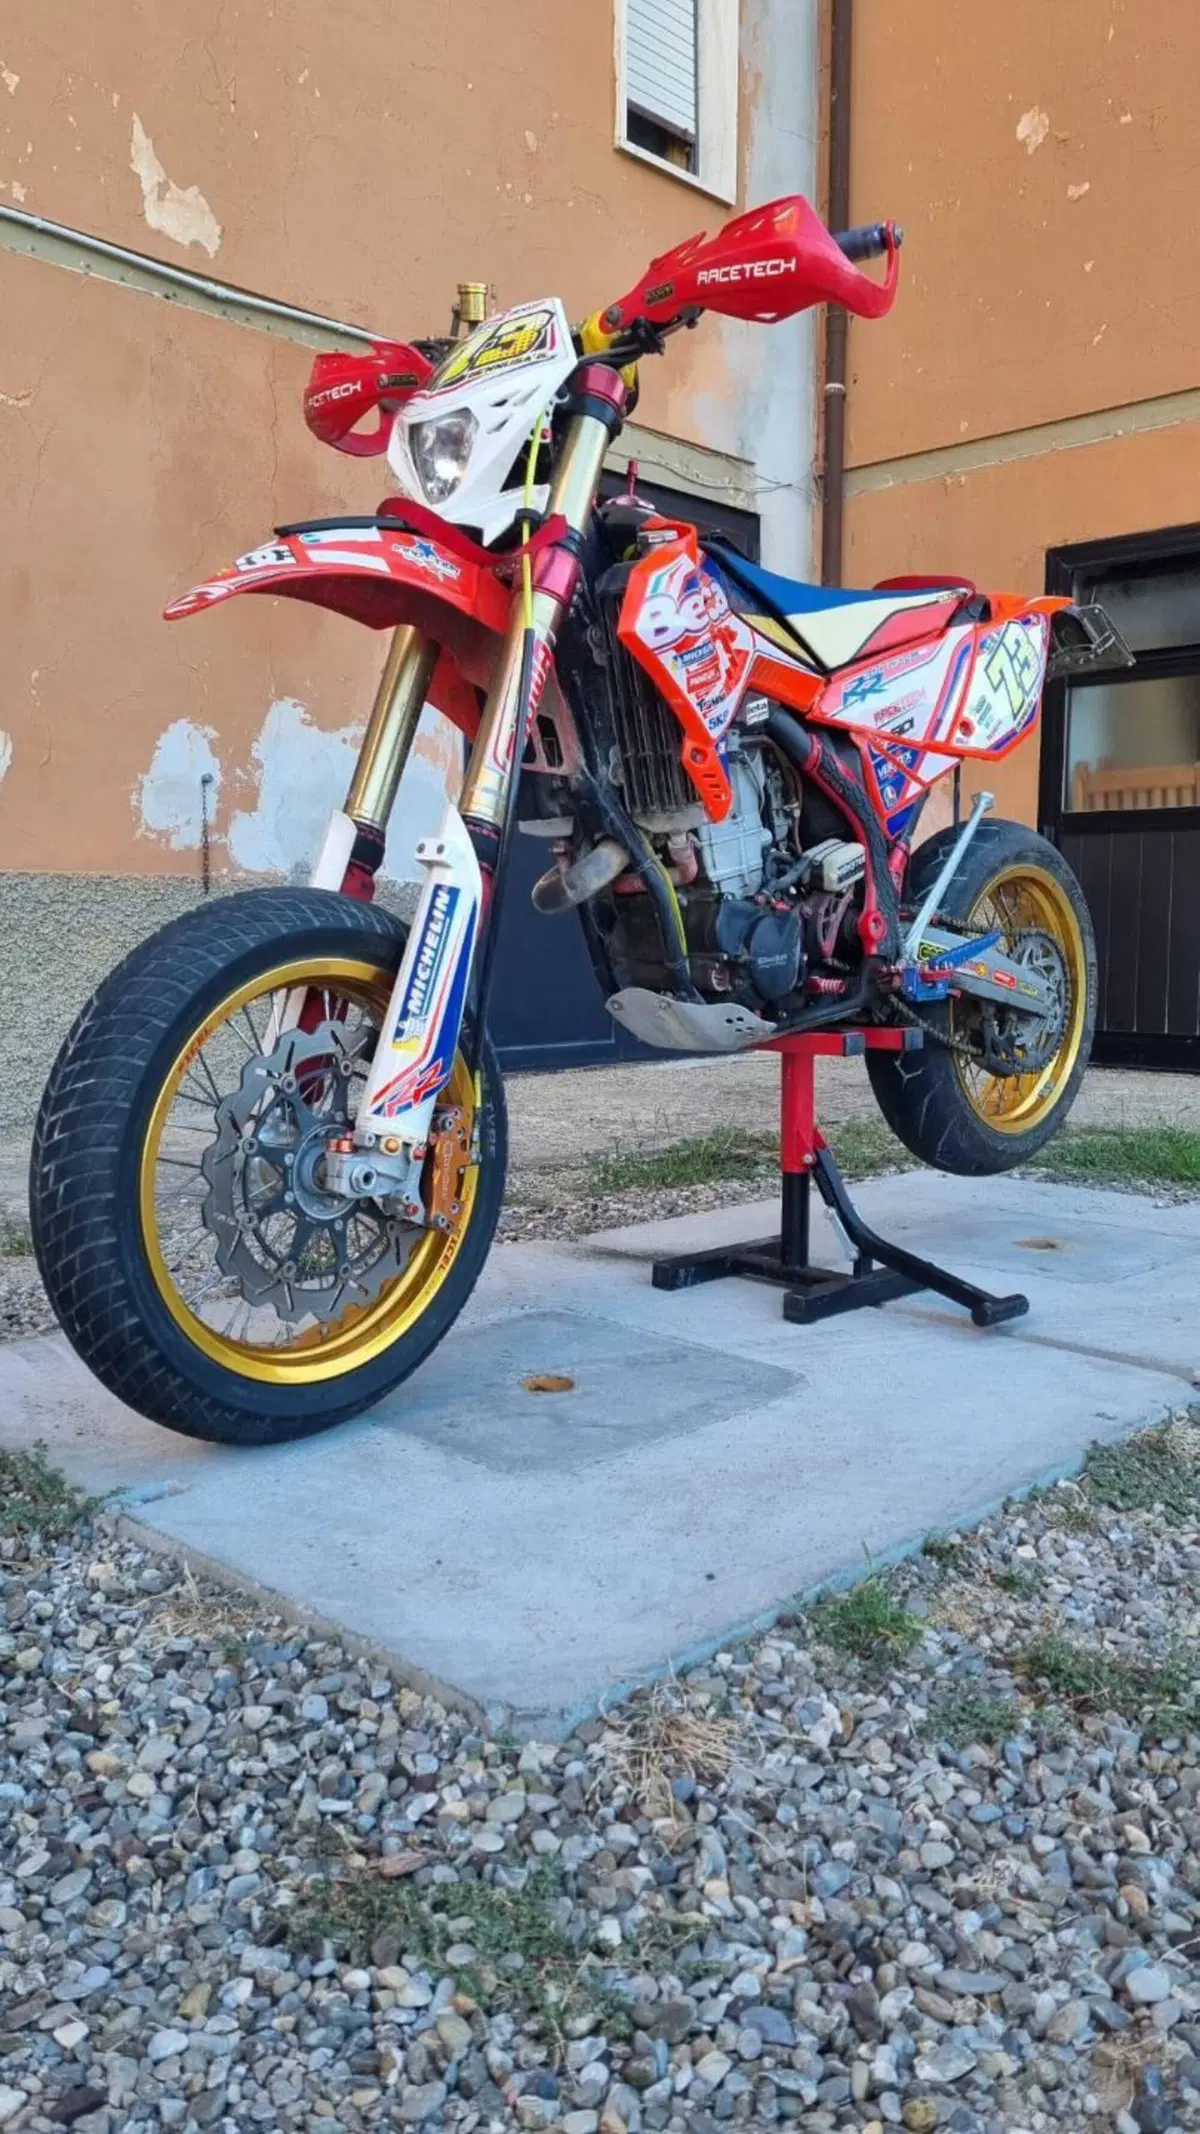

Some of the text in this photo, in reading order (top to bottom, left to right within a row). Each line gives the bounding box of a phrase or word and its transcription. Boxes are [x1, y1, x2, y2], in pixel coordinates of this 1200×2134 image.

[696, 256, 797, 286] RACETECH
[634, 574, 729, 652] Beta
[984, 621, 1042, 722] 73
[407, 886, 452, 1016] MICHELIN
